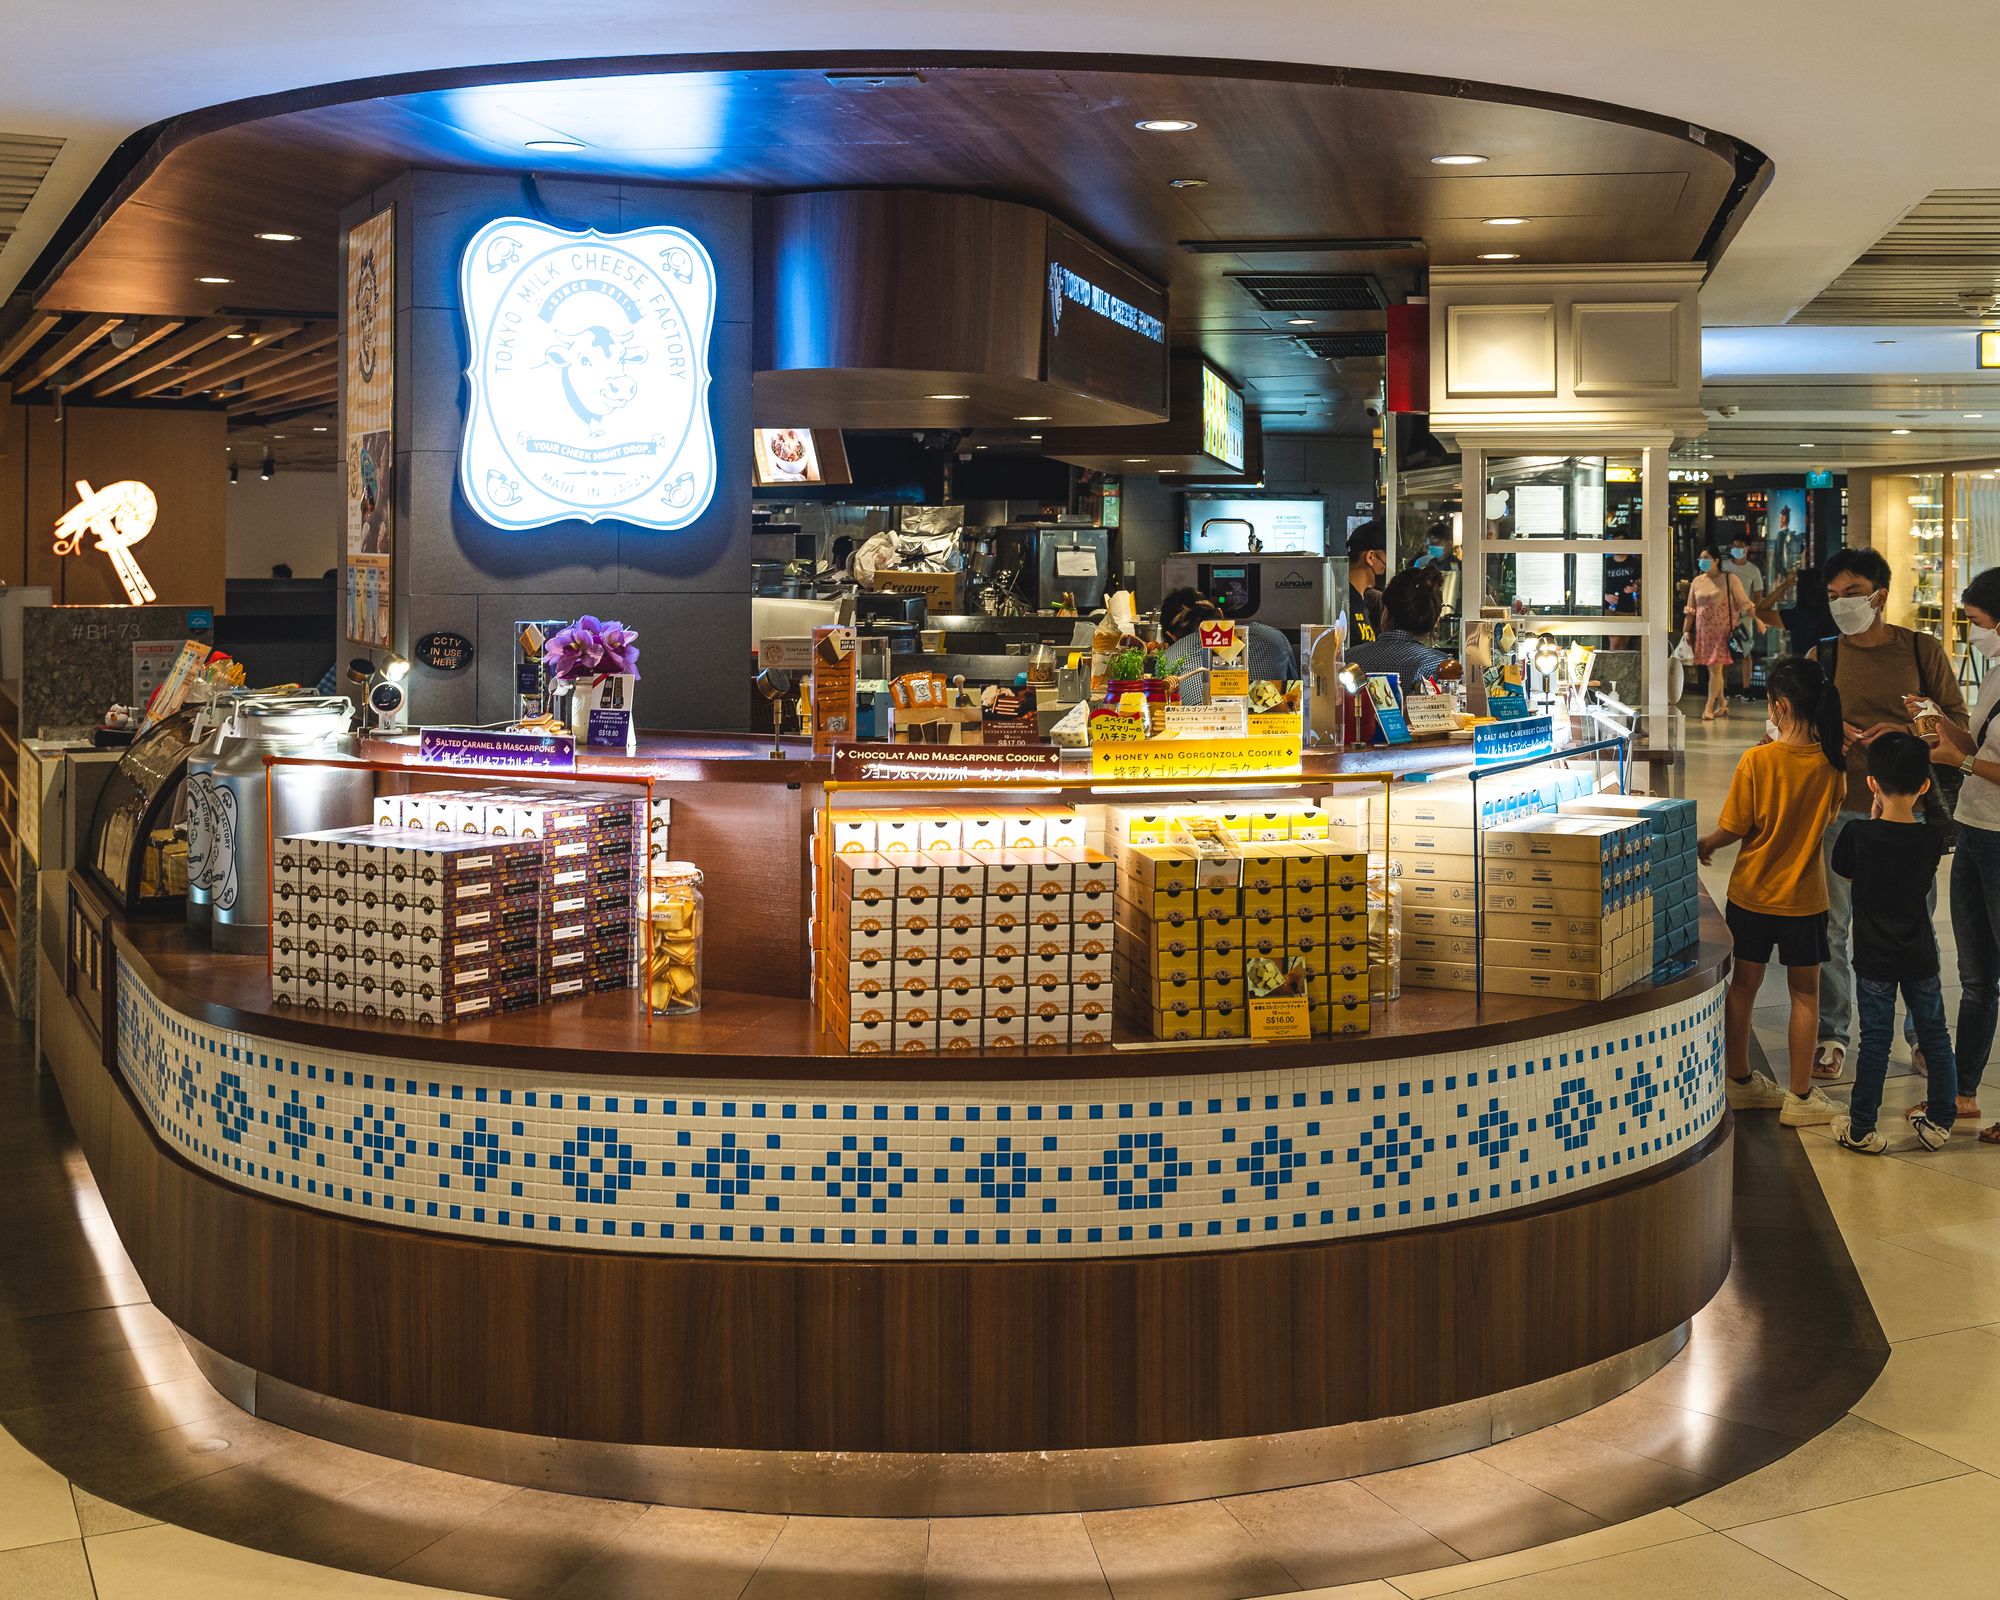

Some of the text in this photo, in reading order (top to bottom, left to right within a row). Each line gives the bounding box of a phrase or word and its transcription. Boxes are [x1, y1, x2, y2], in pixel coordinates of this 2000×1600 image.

[551, 280, 588, 306] SINCE
[1063, 268, 1090, 307] TOKYO
[1090, 284, 1110, 318] MILK
[1110, 296, 1138, 331] CHEESE
[495, 253, 686, 380] TOKYO MILK CHEESE FACTORY
[534, 441, 560, 453] YOUR
[881, 581, 939, 594] Creamer
[72, 624, 140, 640] #B1-73
[1205, 631, 1229, 645] 第2位
[433, 637, 462, 646] CCTV
[430, 647, 462, 657] IN USE
[433, 657, 457, 666] HERE
[1096, 724, 1142, 732] ローズマリーの
[1484, 725, 1549, 741] SALT AND CAMEMBERT COOKIE
[1100, 733, 1137, 741] ハチミツ
[436, 737, 556, 753] SALTED CARAMEL & MASCARPONE
[848, 750, 1046, 763] CHOCOLAT AND MASCARPONE COOKIE
[1115, 749, 1283, 761] HONEY AND GORGONZOLA COOKIE
[199, 797, 211, 832] FACTORY
[220, 811, 231, 850] FACTORY
